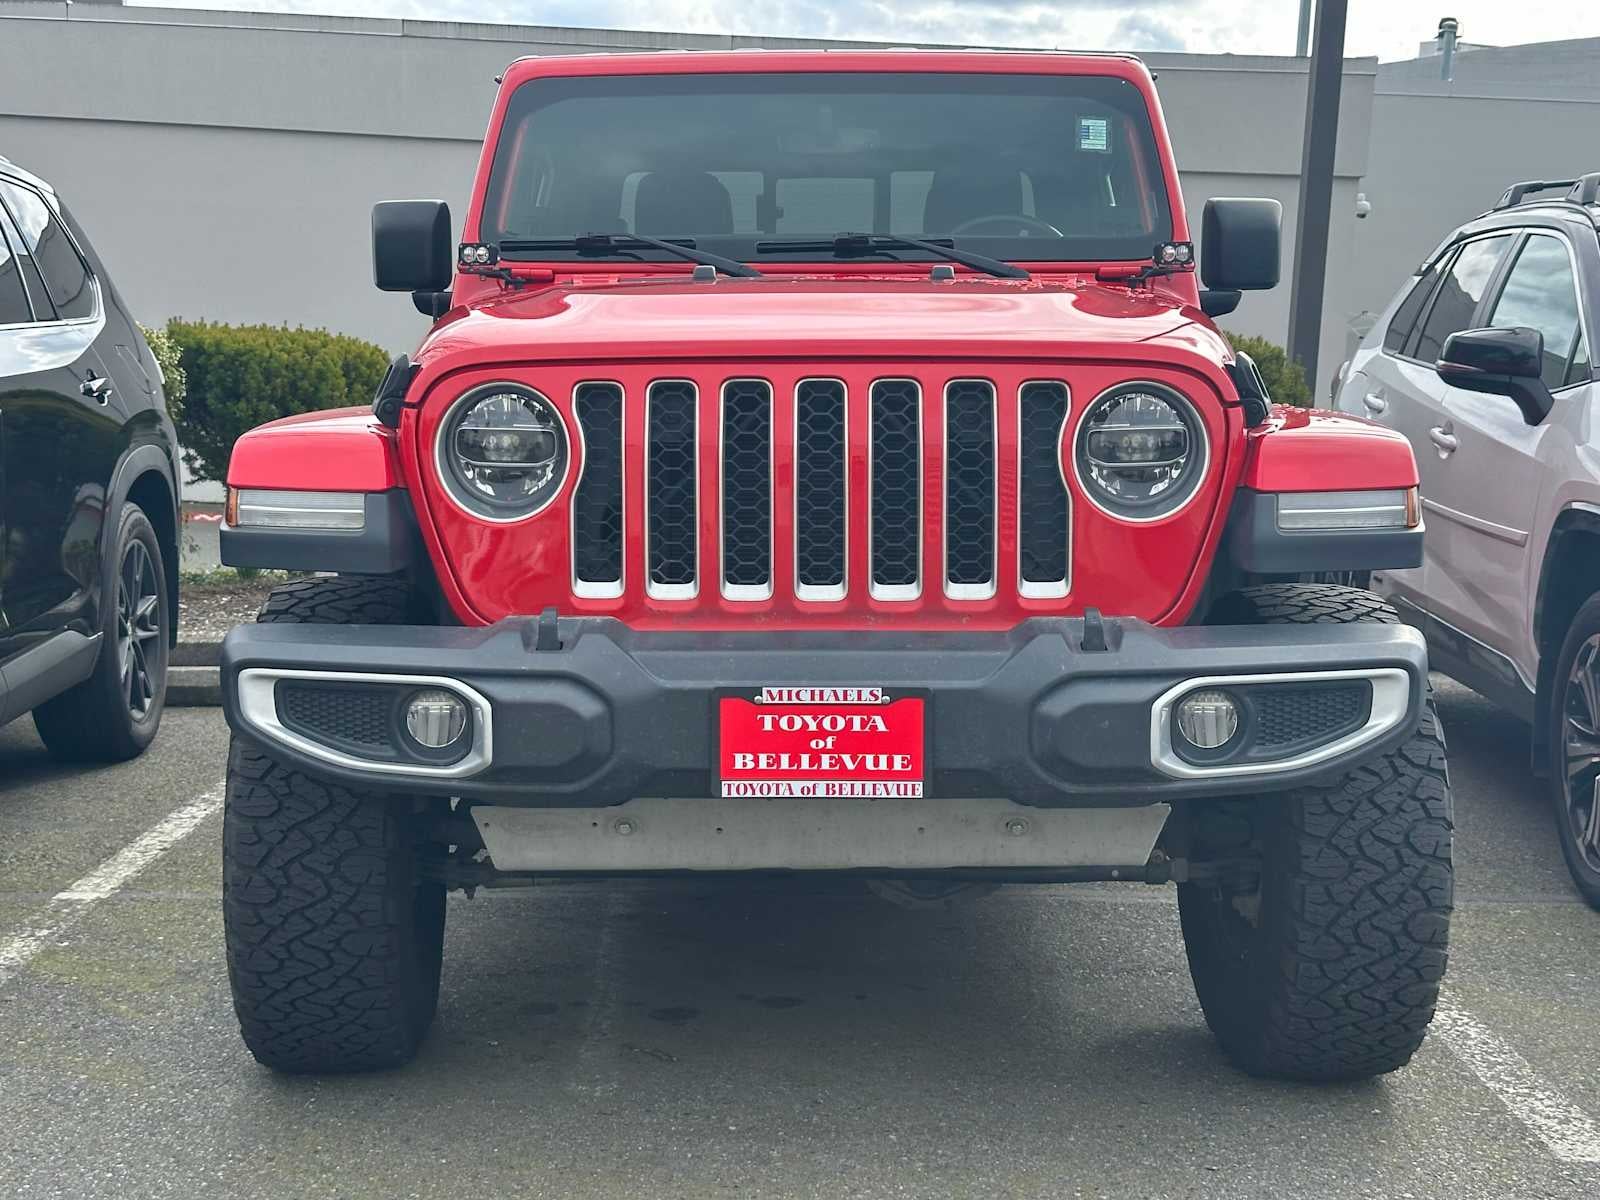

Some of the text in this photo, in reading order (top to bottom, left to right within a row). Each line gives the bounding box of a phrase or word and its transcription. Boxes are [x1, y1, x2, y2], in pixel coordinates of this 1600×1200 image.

[765, 690, 880, 702] MICHAELS
[757, 714, 888, 732] TOYOTA
[810, 736, 836, 749] of
[733, 754, 912, 770] BELLEVUE
[724, 782, 921, 796] TOYOTA of BELLEVUE
